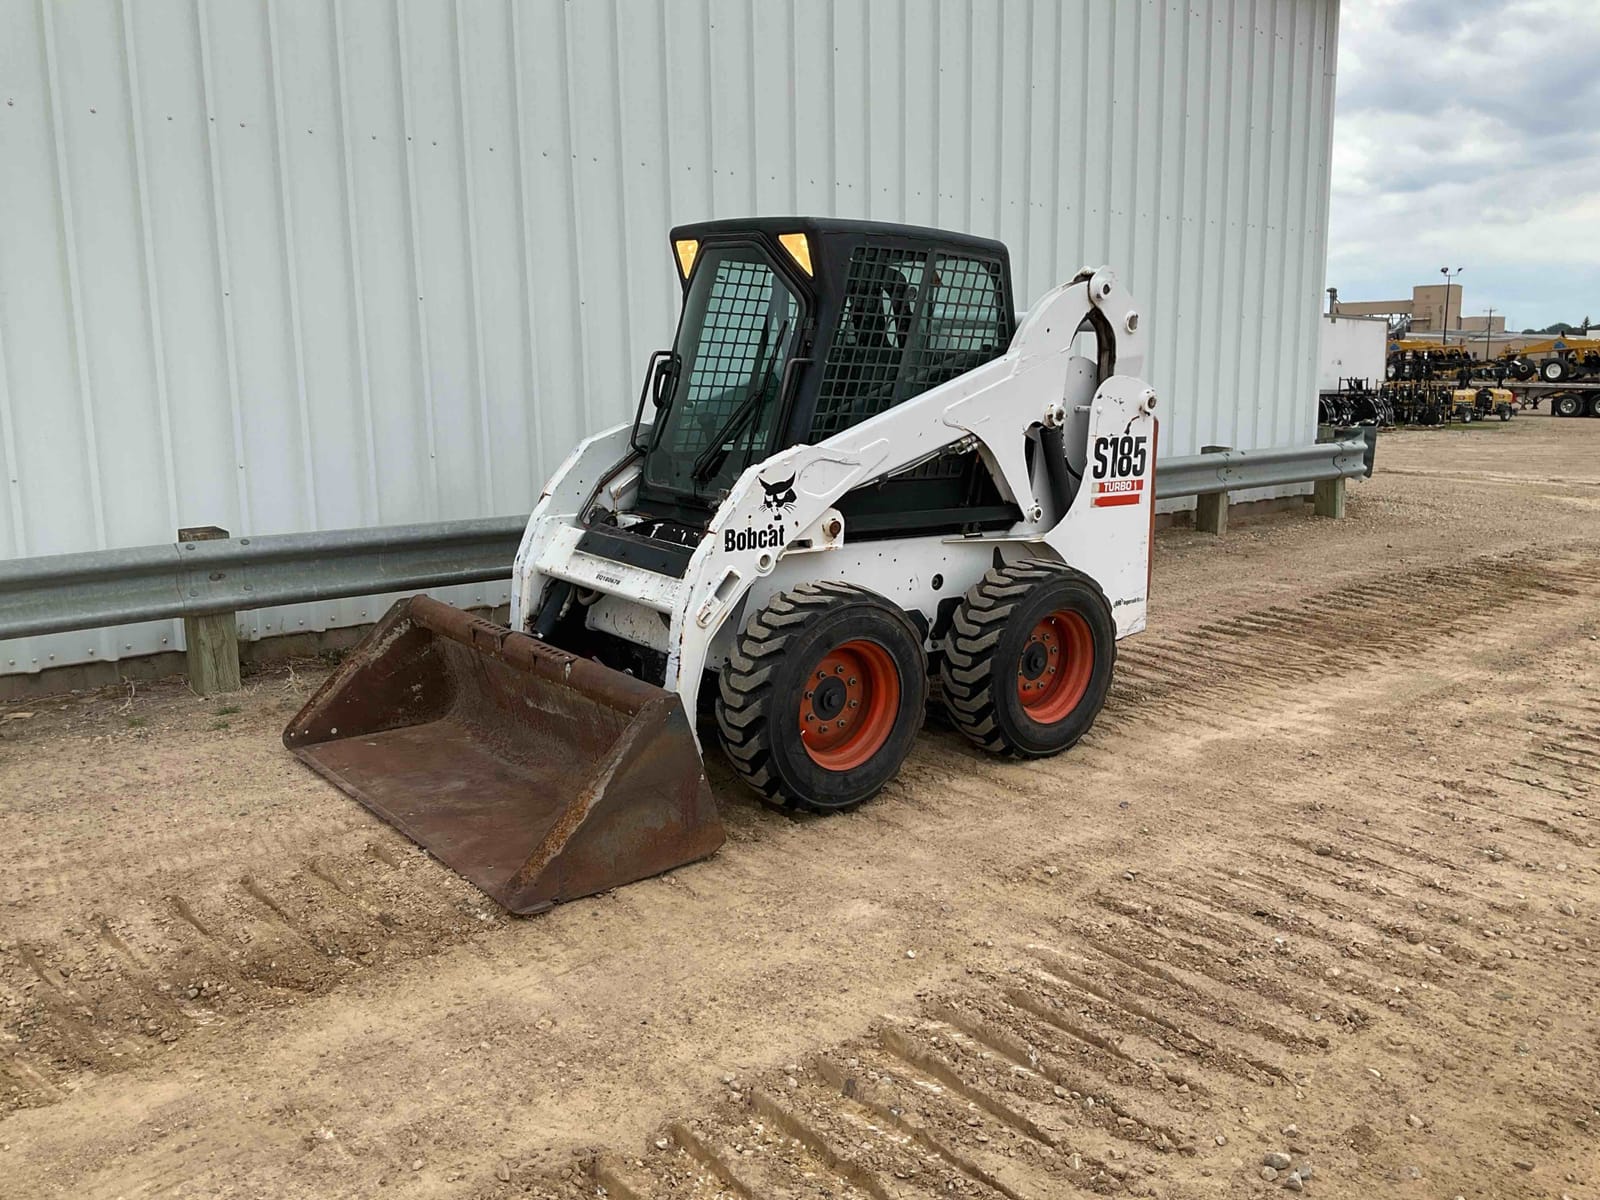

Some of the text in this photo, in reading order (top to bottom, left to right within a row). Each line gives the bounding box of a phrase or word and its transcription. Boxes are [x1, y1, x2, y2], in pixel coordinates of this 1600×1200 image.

[1093, 436, 1147, 479] S185
[1104, 481, 1132, 492] TURBO
[724, 525, 785, 552] Bobcat
